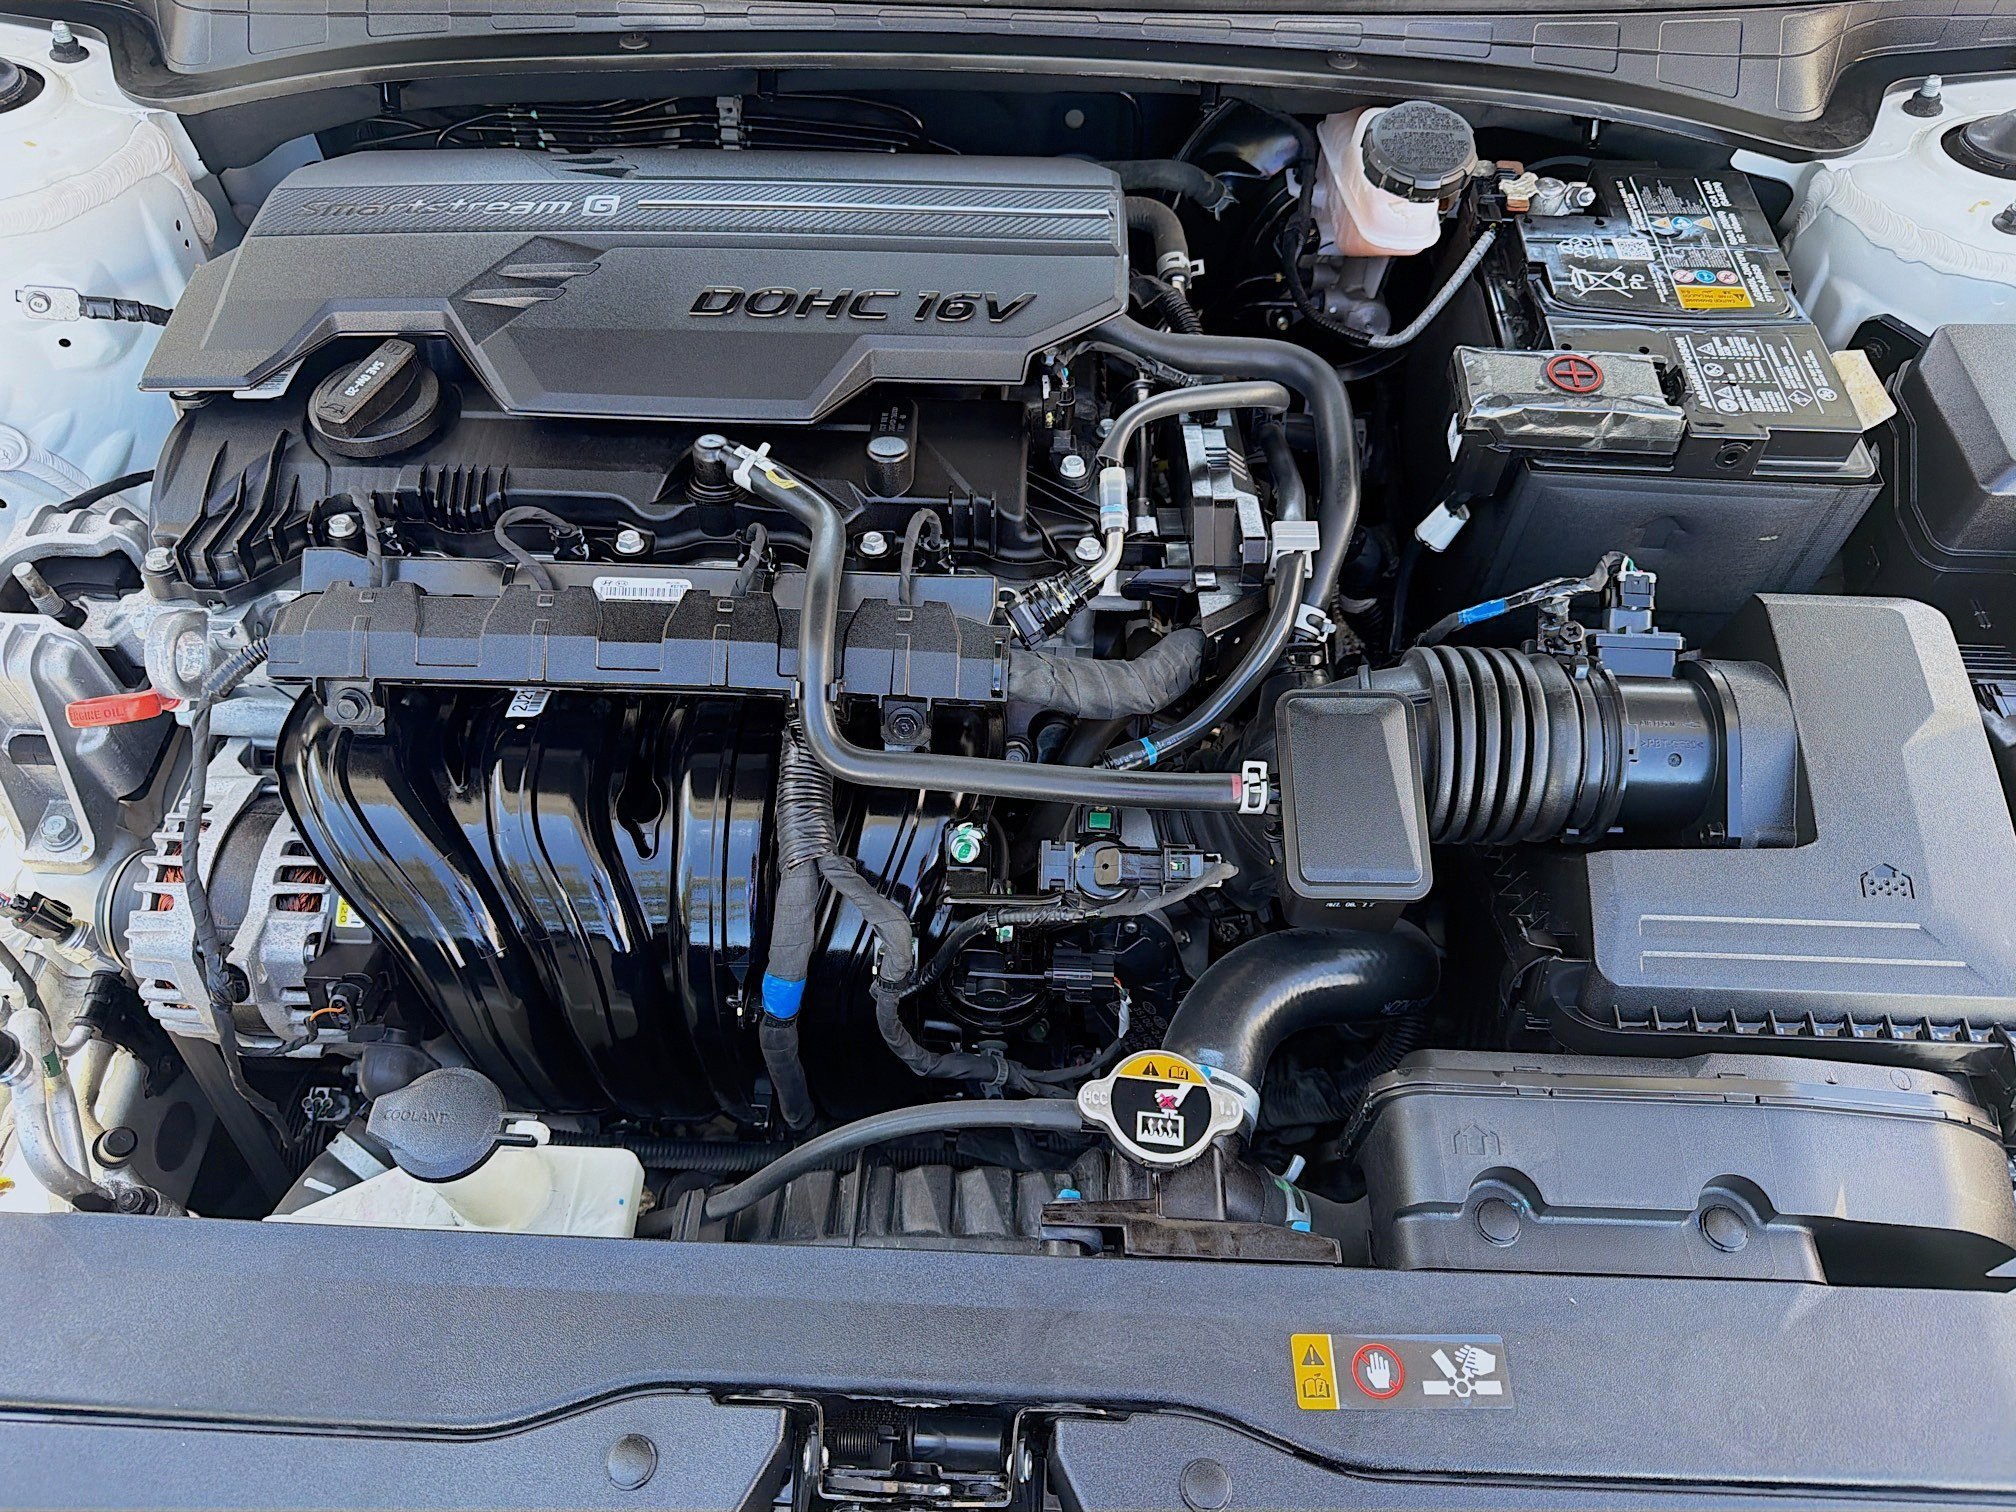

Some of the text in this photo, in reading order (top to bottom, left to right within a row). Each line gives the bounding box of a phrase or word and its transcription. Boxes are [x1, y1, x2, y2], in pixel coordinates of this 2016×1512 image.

[1629, 274, 1648, 289] Pb
[689, 285, 1038, 322] DOHC 16V
[344, 360, 385, 397] SAE 0W-20
[1083, 1090, 1108, 1106] HCC
[383, 1108, 448, 1122] COOLANT
